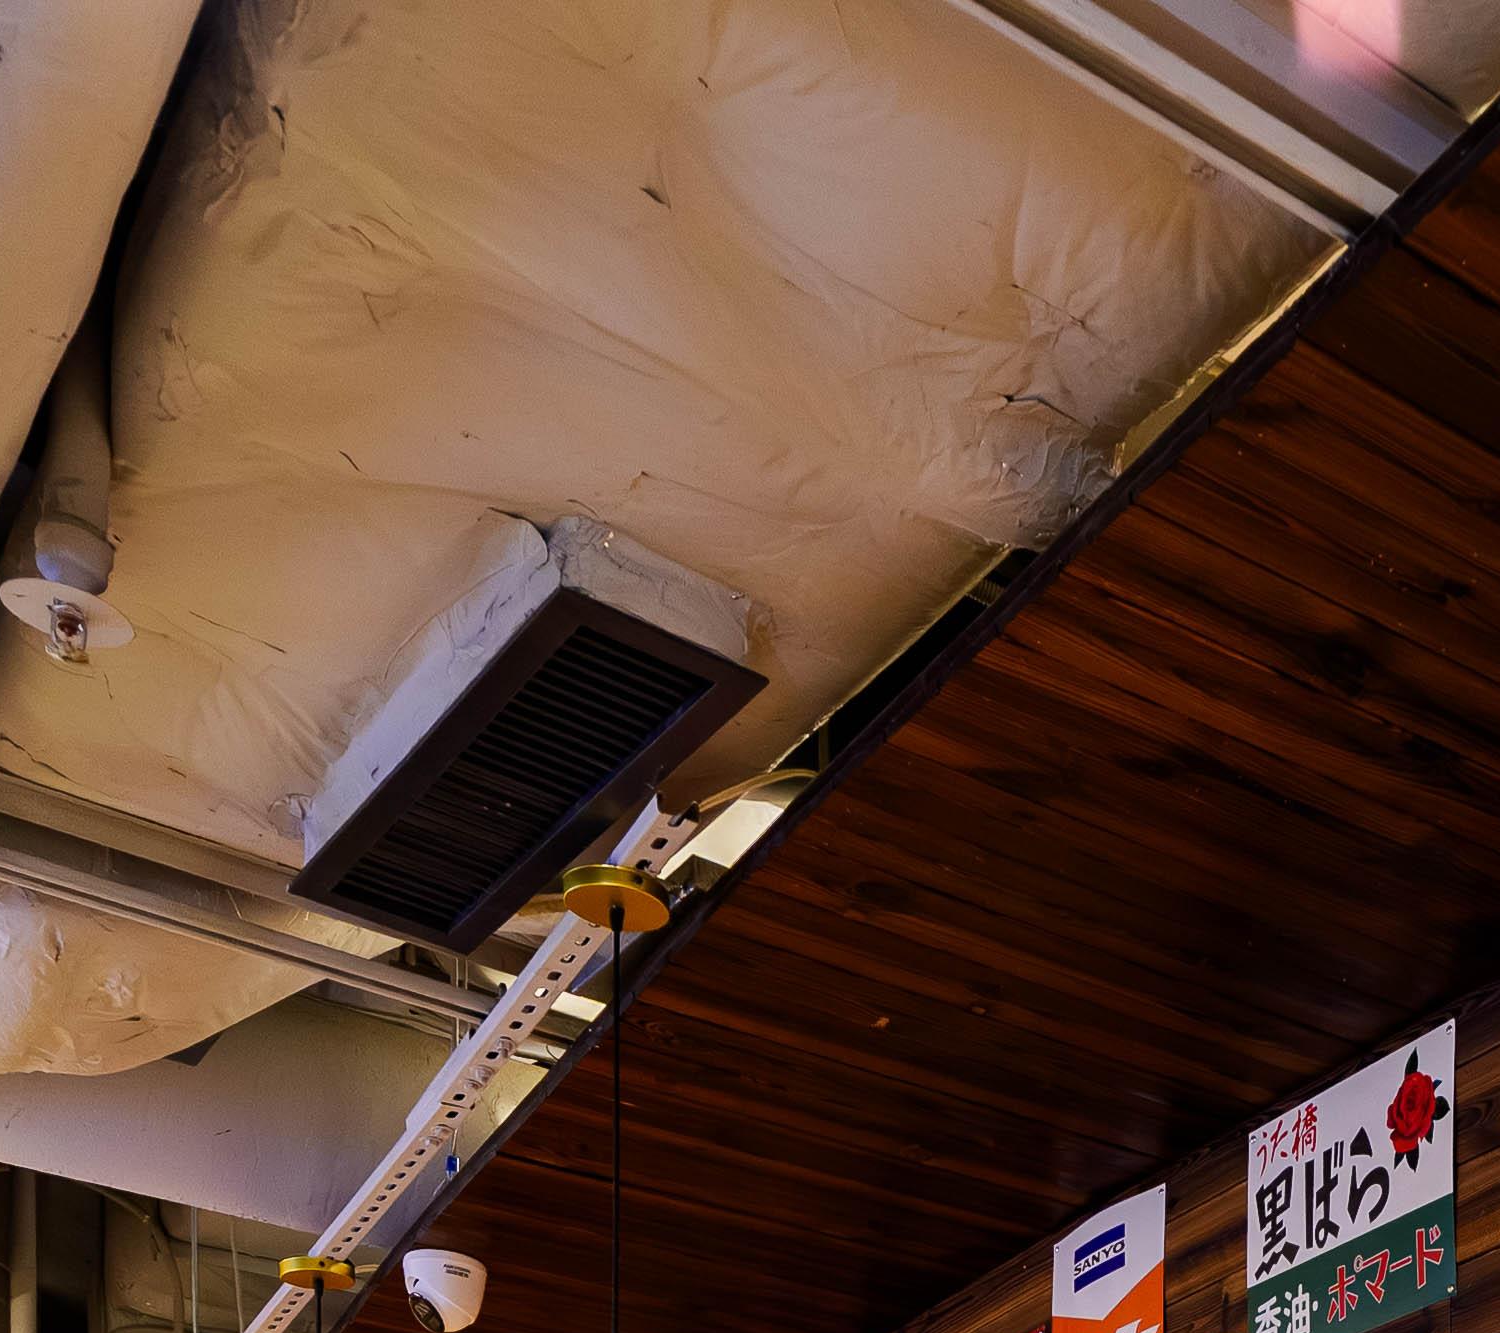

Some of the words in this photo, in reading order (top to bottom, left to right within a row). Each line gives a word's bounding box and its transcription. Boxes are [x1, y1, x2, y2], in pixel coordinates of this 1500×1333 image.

[1254, 1127, 1391, 1281] 黒ばら
[1073, 1239, 1126, 1277] SANYO
